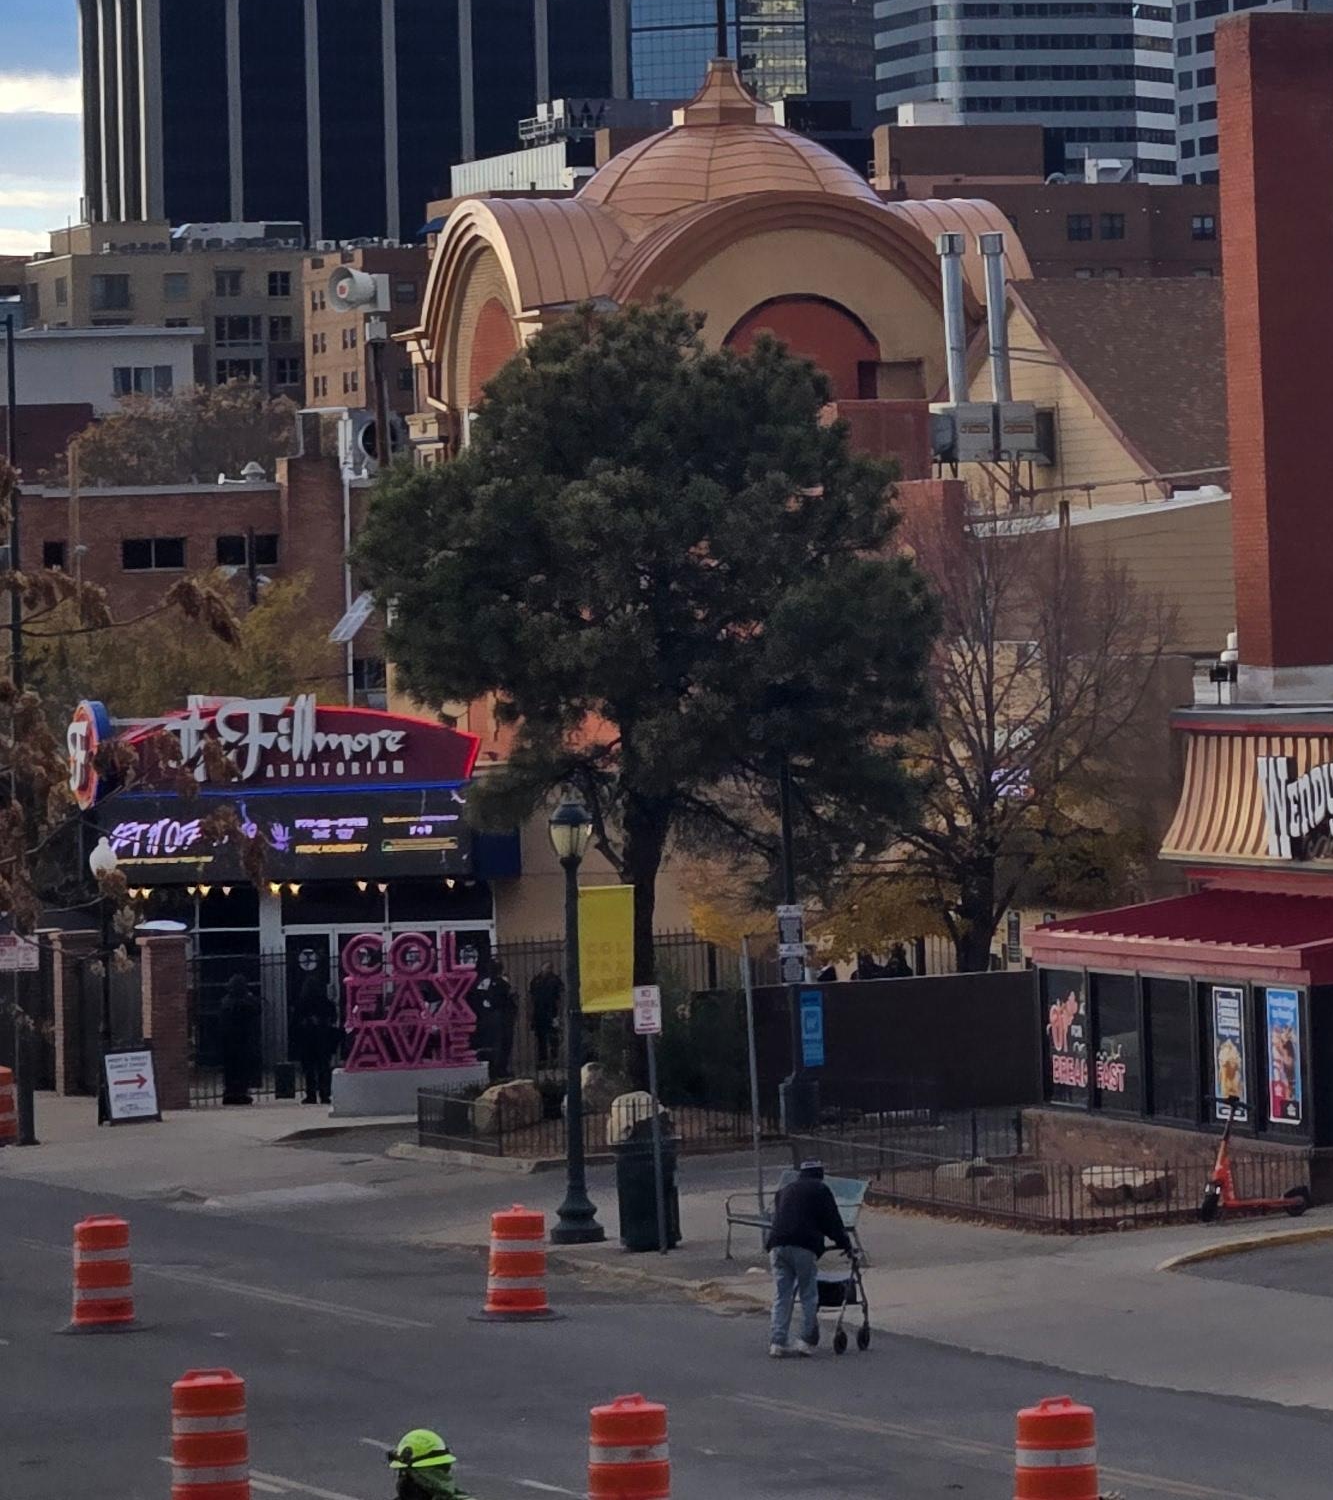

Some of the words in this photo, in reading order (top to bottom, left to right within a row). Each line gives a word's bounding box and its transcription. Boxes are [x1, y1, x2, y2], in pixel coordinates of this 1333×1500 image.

[215, 694, 406, 782] Fillmore
[265, 760, 405, 778] AUDITORIUM
[341, 931, 476, 977] COL
[342, 971, 478, 1027] FAX
[345, 1023, 478, 1073] AVE
